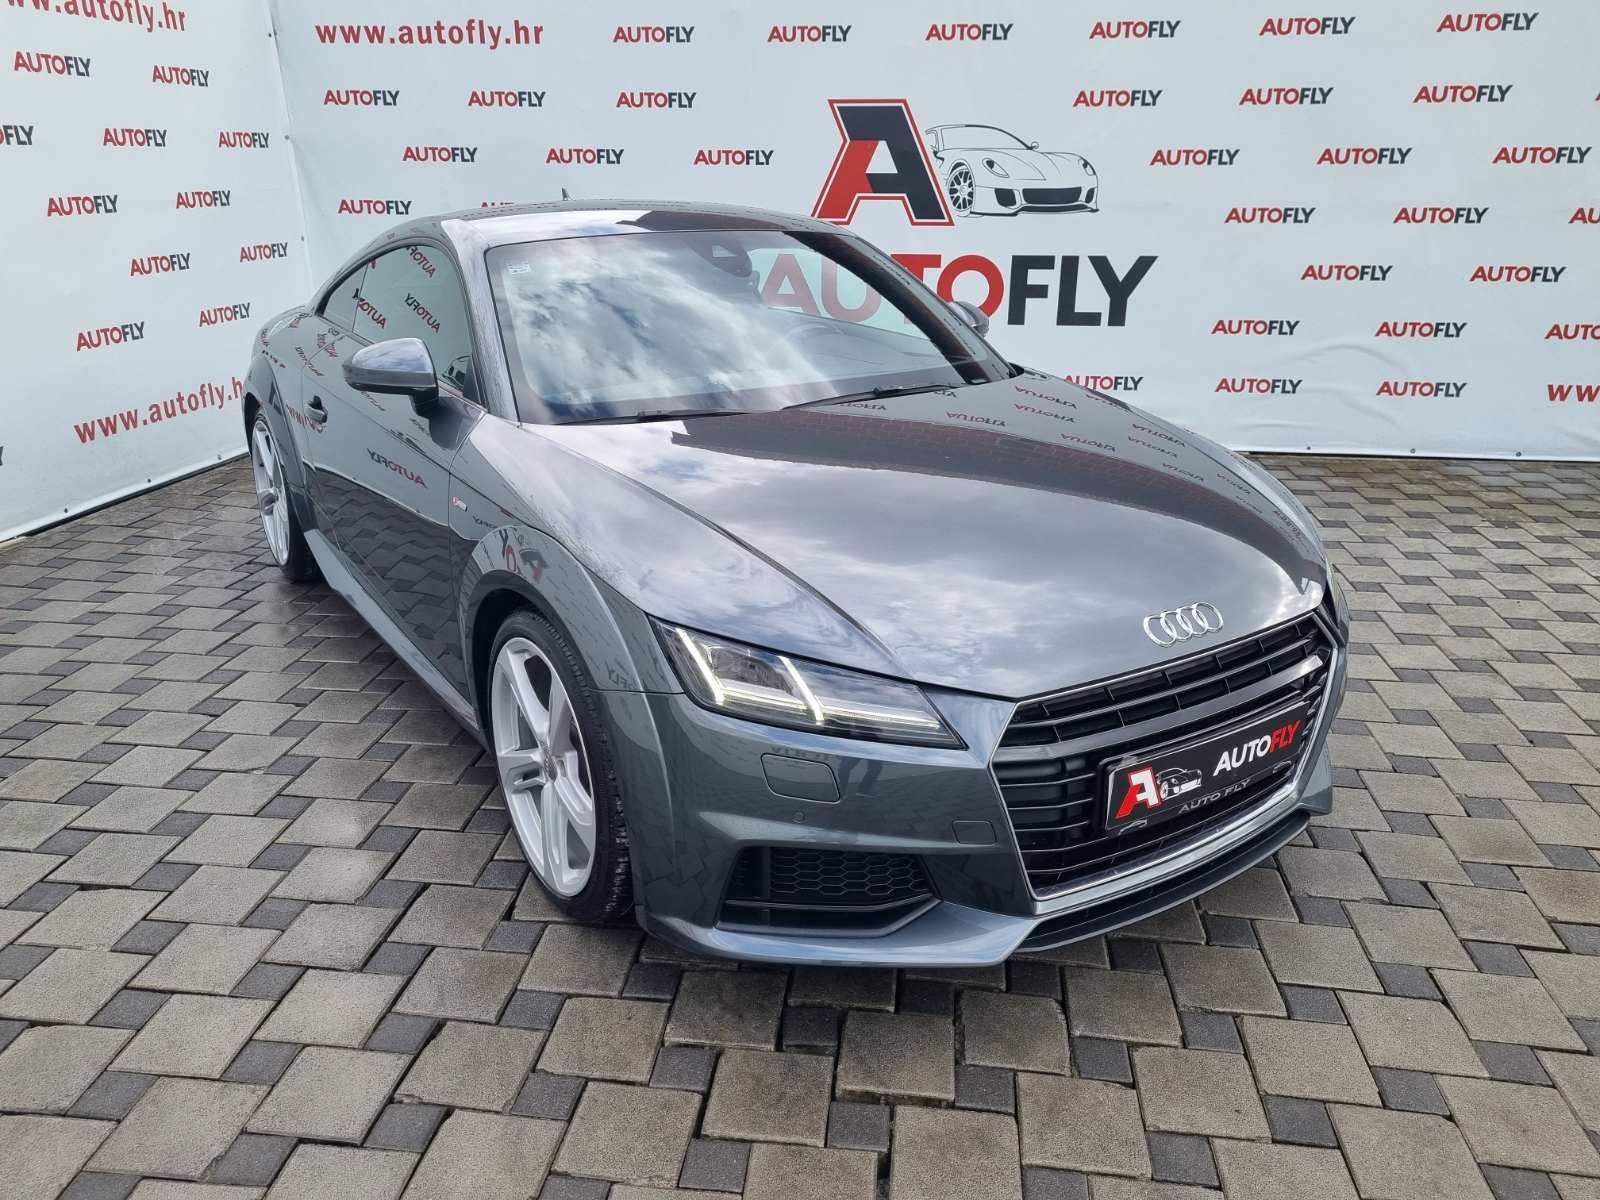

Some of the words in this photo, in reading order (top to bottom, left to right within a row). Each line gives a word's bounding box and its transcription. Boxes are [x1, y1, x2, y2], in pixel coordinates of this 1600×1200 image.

[1089, 20, 1181, 39] AUTOFLY
[1259, 16, 1356, 36] AUTOFLY
[1436, 12, 1539, 32] AUTOFLY
[315, 18, 544, 50] www.autofly.hr
[613, 26, 695, 43] AUTOFLY
[767, 25, 852, 43] AUTOFLY
[925, 23, 1014, 41] AUTOFLY
[14, 51, 91, 77] AUTOFLY
[153, 65, 209, 87] AUTOFLY
[324, 89, 400, 106] AUTOFLY
[468, 90, 546, 108] AUTOFLY
[616, 92, 697, 109] AUTOFLY
[1073, 89, 1163, 108] AUTOFLY
[1239, 87, 1334, 106] AUTOFLY
[1413, 84, 1513, 104] AUTOFLY
[0, 125, 34, 146] FLY
[103, 128, 167, 147] AUTOFLY
[218, 131, 270, 148] AUTOFLY
[402, 146, 478, 163] AUTOFLY
[546, 147, 624, 165] AUTOFLY
[694, 149, 775, 166] AUTOFLY
[1150, 149, 1240, 166] AUTOFLY
[1317, 147, 1413, 165] AUTOFLY
[1492, 146, 1592, 164] AUTOFLY
[47, 195, 118, 217] AUTOFLY
[176, 190, 231, 209] AUTOFLY
[338, 200, 413, 215] AUTOFLY
[1224, 207, 1316, 224] AUTOFLY
[1393, 207, 1489, 225] AUTOFLY
[239, 242, 289, 263] AUTOFLY
[130, 253, 191, 276] AUTOFLY
[1301, 264, 1393, 281] AUTOFLY
[1469, 265, 1566, 282] AUTOFLY
[199, 302, 251, 327] AUTOFLY
[76, 321, 145, 352] AUTOFLY
[1211, 319, 1300, 336] AUTOFLY
[1375, 320, 1467, 338] AUTOFLY
[1215, 378, 1303, 395] AUTOFLY
[1376, 381, 1468, 398] AUTOFLY
[74, 376, 244, 444] www.autofly.h
[1212, 720, 1300, 777] AUTOFLY
[1177, 794, 1222, 815] AUTO
[1224, 778, 1252, 796] FLY
